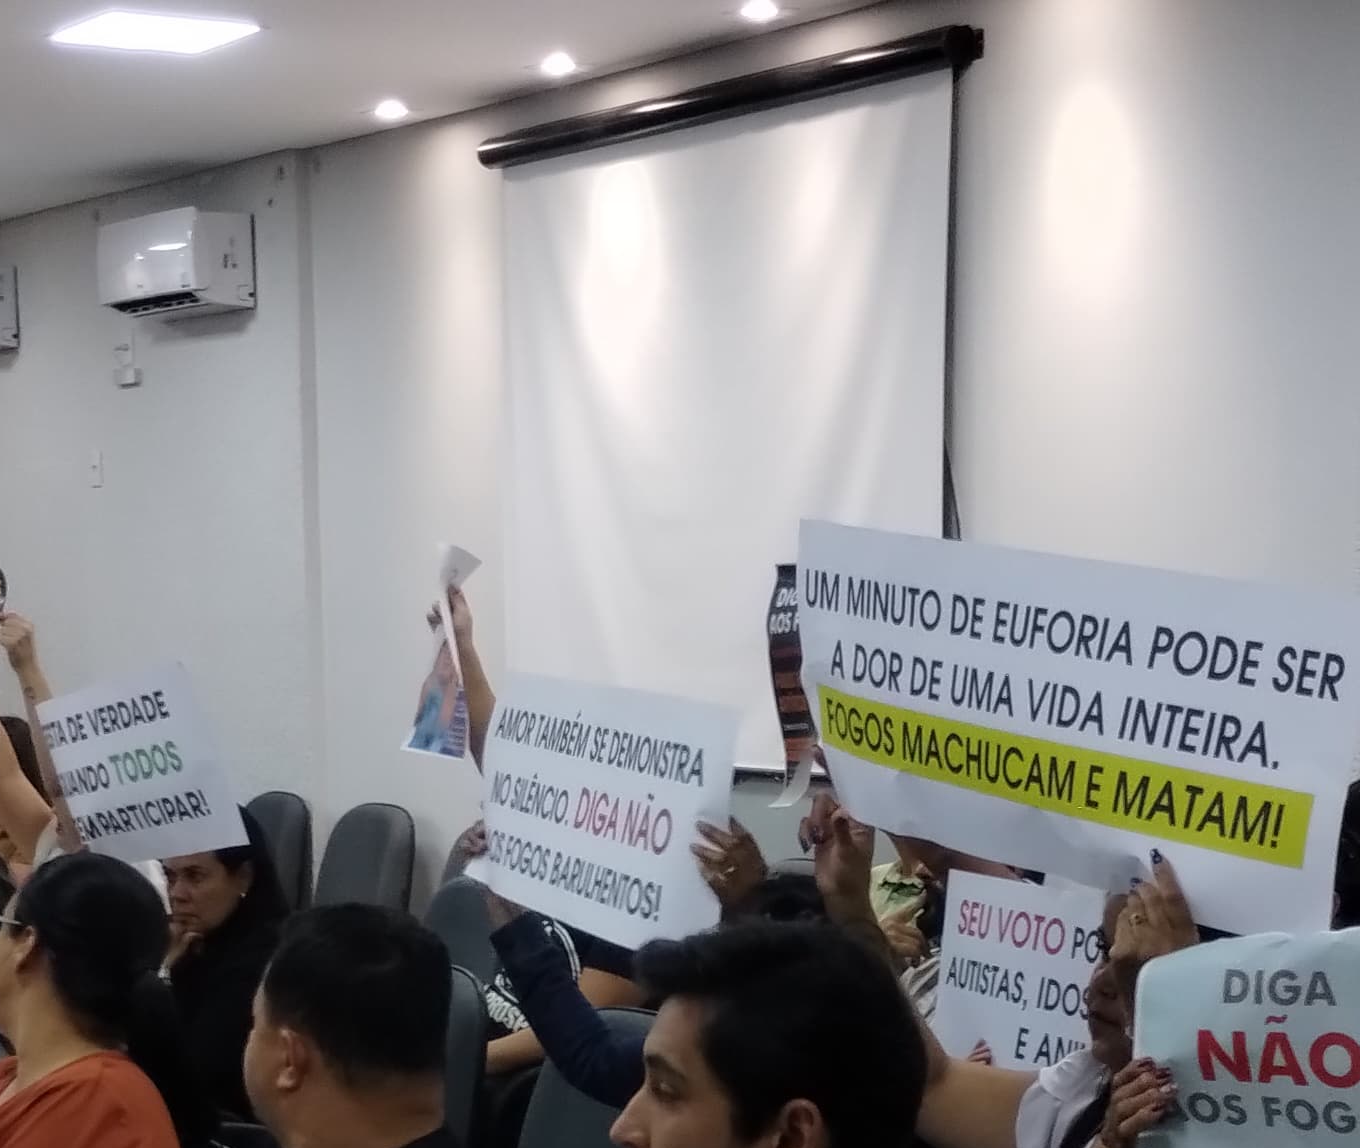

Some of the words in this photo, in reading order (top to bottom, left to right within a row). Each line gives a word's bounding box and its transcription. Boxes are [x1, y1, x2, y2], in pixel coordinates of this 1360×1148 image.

[805, 568, 840, 613] UM
[846, 578, 941, 631] MINUTO
[950, 594, 986, 639] DE
[992, 601, 1134, 667] EUFORIA
[1147, 626, 1264, 688] PODE
[1272, 645, 1346, 701] SER
[66, 713, 88, 744] DE
[86, 690, 171, 737] VERDADE
[831, 639, 846, 680] A
[852, 646, 902, 690] DOR
[909, 655, 943, 701] DE
[949, 665, 1015, 717] UMA
[1027, 678, 1105, 736] VIDA
[1118, 694, 1281, 771] INTEIRA.
[108, 740, 184, 786] TODOS
[495, 707, 538, 749] AMOR
[538, 710, 591, 759] TAMBÉM
[589, 727, 608, 763] SE
[608, 730, 704, 787] DEMONSTRA
[825, 697, 895, 757] FOGOS
[901, 721, 1077, 804] MACHUCAM
[1085, 764, 1104, 809] E
[1112, 769, 1287, 849] MATAM!
[97, 789, 213, 837] PARTICIPAR!
[492, 771, 511, 804] NO
[510, 772, 570, 828] SILÊNCIO.
[573, 786, 620, 840] DIGA
[622, 793, 673, 856] NÃO
[504, 833, 551, 881] FOGOS
[548, 852, 663, 922] BARULHENTOS!
[958, 900, 993, 940] SEU
[998, 907, 1066, 955] VOTO
[1071, 927, 1104, 963] PO
[946, 957, 1028, 1011] AUTISTAS,
[1036, 976, 1090, 1021] IDOS
[1222, 968, 1338, 1007] DIGA
[1014, 1027, 1030, 1060] E
